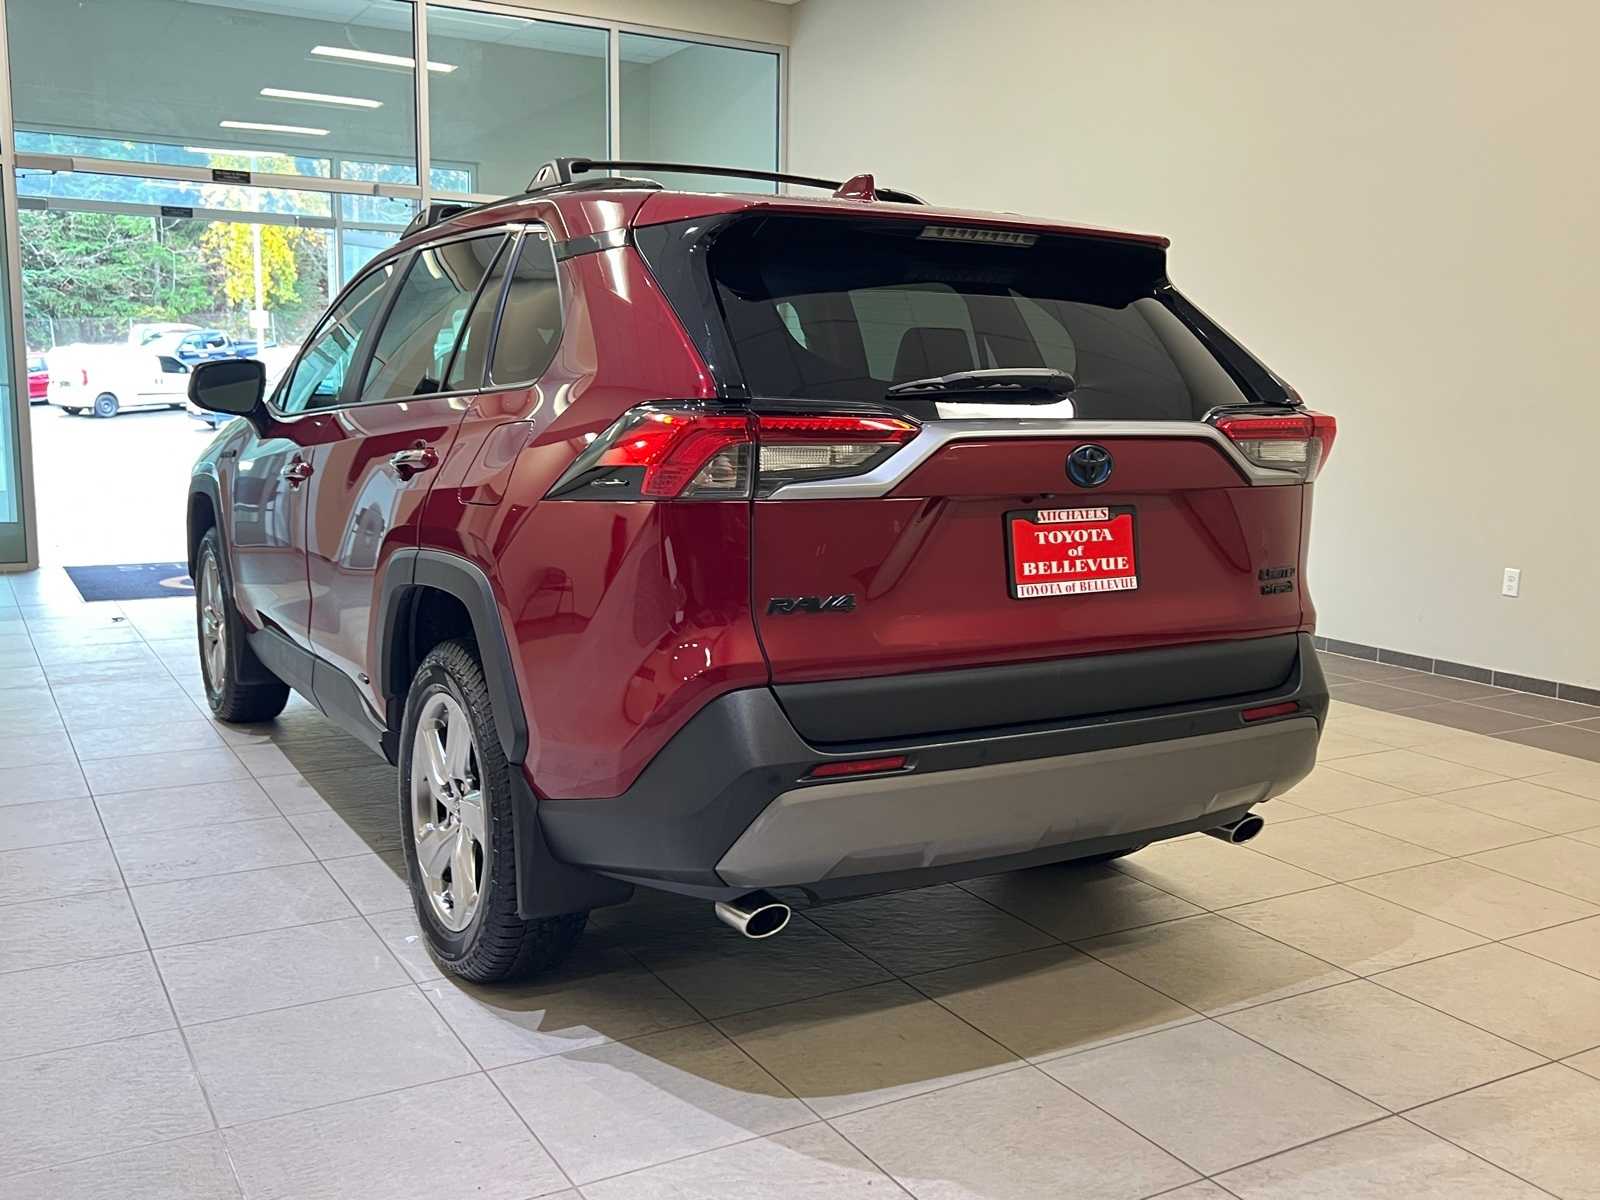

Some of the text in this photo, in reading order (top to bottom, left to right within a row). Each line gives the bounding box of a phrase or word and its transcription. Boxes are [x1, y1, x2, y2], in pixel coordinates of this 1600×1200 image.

[1038, 508, 1108, 521] MICHAELS
[1034, 528, 1113, 545] TOYOTA
[1067, 545, 1084, 557] of
[1022, 556, 1129, 576] BELLEVUE
[1019, 578, 1135, 597] TOYOTA of BELLEVUE
[766, 594, 856, 615] RAV4
